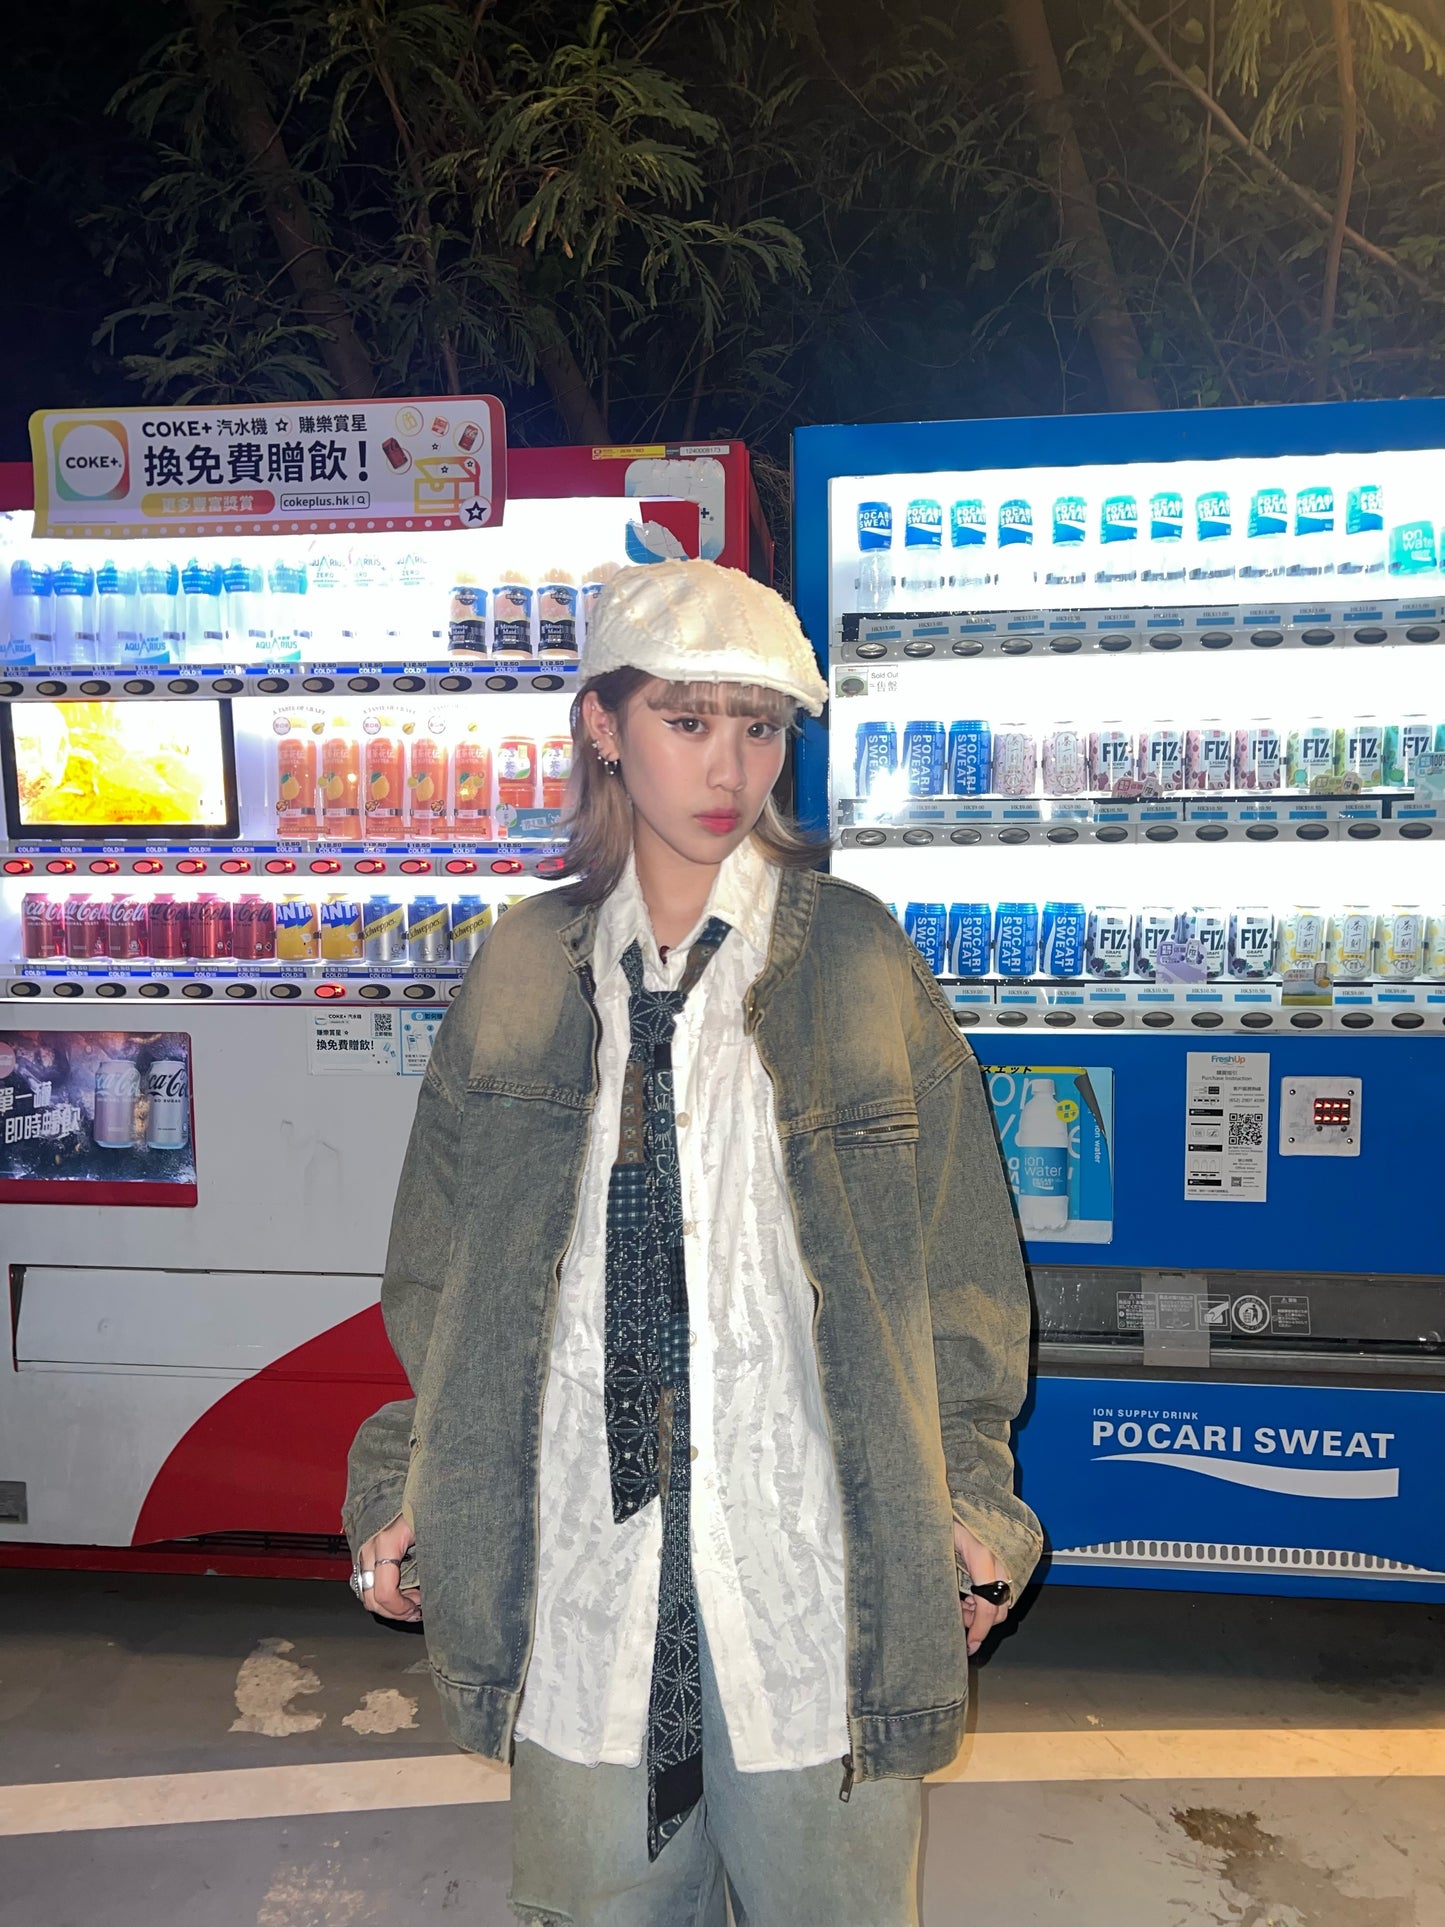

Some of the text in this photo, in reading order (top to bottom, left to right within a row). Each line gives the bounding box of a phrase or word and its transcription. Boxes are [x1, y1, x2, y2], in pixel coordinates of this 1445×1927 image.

[142, 420, 213, 438] COKE+
[216, 417, 268, 437] 汽水機
[282, 496, 350, 509] cokeplus.hk
[860, 519, 889, 528] SWEAT
[908, 516, 938, 524] SWEAT
[125, 639, 166, 656] AQUARIUS
[1102, 742, 1129, 762] FIZ
[1152, 742, 1178, 762] FIZ
[1204, 740, 1229, 760] FIZ
[1252, 740, 1278, 760] FIZ
[1303, 738, 1330, 758] FIZ
[1350, 738, 1378, 759] FIZ
[911, 734, 922, 786] SWEAT
[920, 734, 932, 792] POCARI
[956, 734, 967, 786] SWEAT
[966, 734, 978, 792] POCARI
[364, 918, 396, 940] Schweppes
[408, 918, 441, 940] Schweppes
[454, 918, 484, 940] Schweppes
[1100, 929, 1127, 950] FIZ
[1240, 928, 1268, 950] FIZ
[962, 917, 972, 968] SWEAT
[972, 917, 982, 972] POCARI
[1002, 916, 1012, 967] SWEAT
[1010, 916, 1022, 972] POCARI
[1054, 916, 1066, 967] SWEAT
[1064, 916, 1076, 972] POCARI
[1211, 1056, 1246, 1064] FreshUp
[1024, 1154, 1044, 1166] ion
[1024, 1166, 1062, 1177] water
[1092, 1408, 1199, 1420] ION SUPPLY DRINK
[1092, 1420, 1395, 1459] POCARI SWEAT
